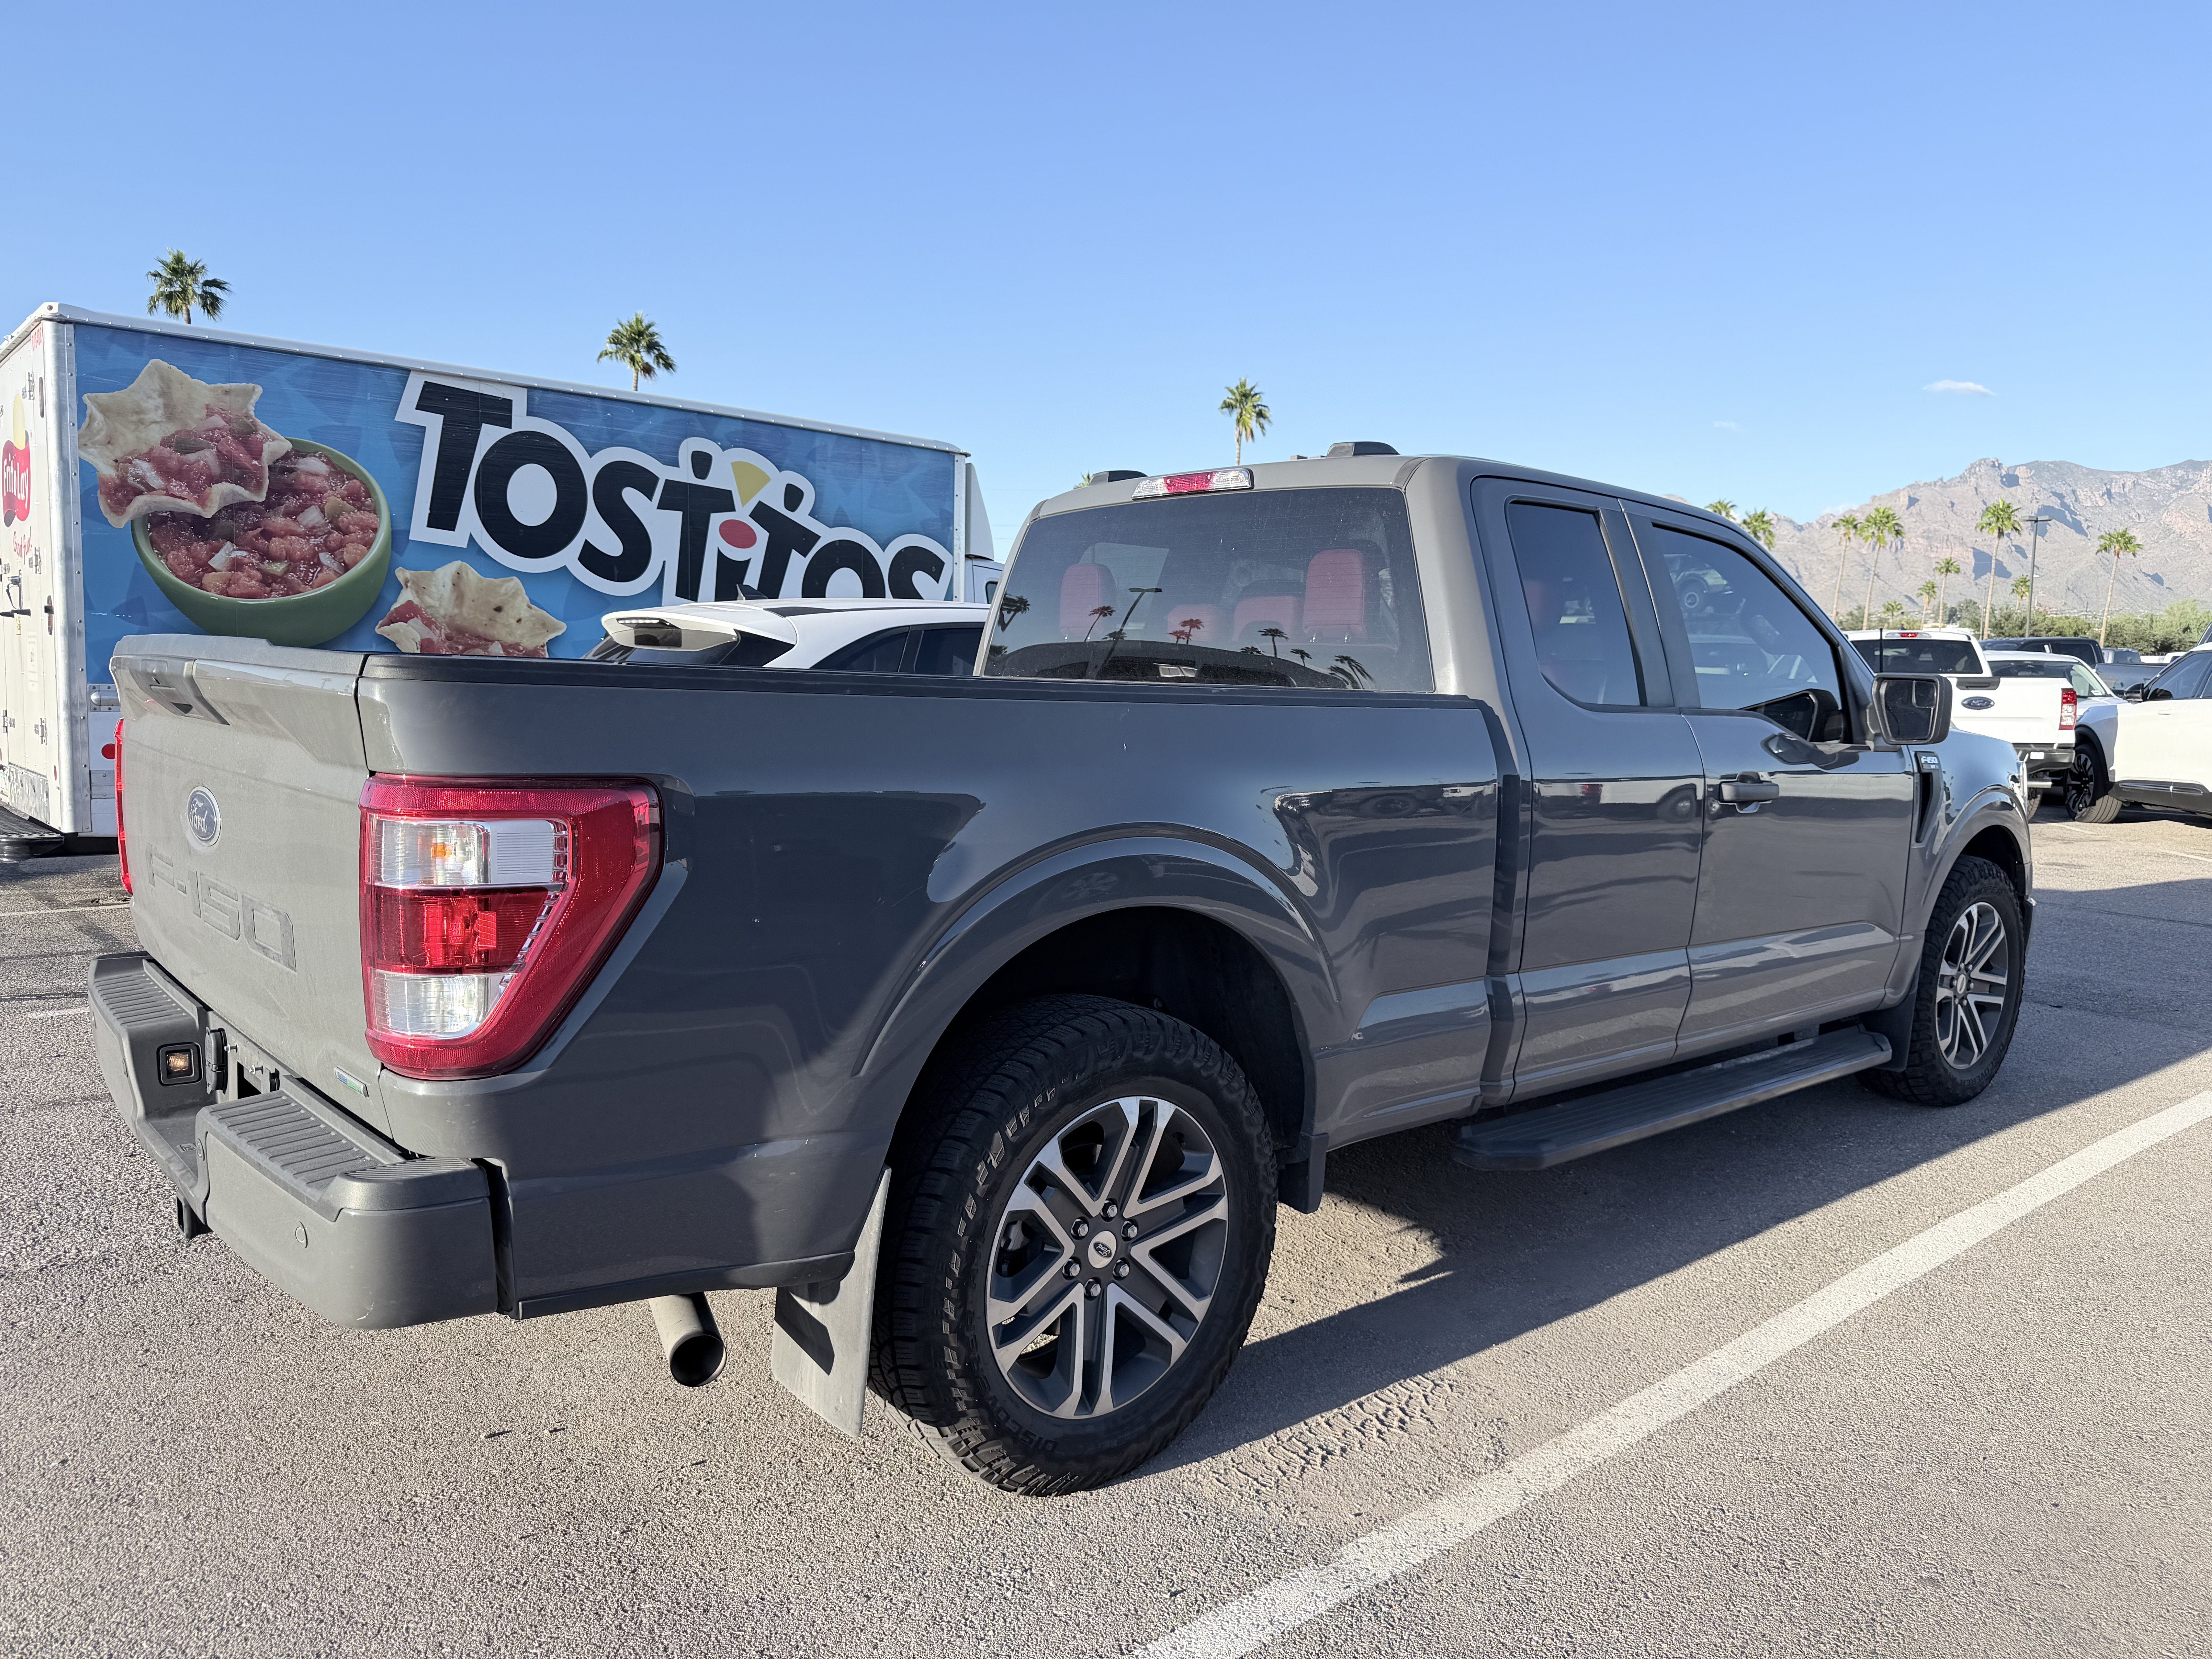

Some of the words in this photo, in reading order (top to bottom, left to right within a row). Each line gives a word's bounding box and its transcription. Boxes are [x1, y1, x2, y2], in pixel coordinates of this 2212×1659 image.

[189, 798, 208, 833] Ford
[146, 845, 297, 972] F-150
[1096, 1243, 1111, 1257] Ford
